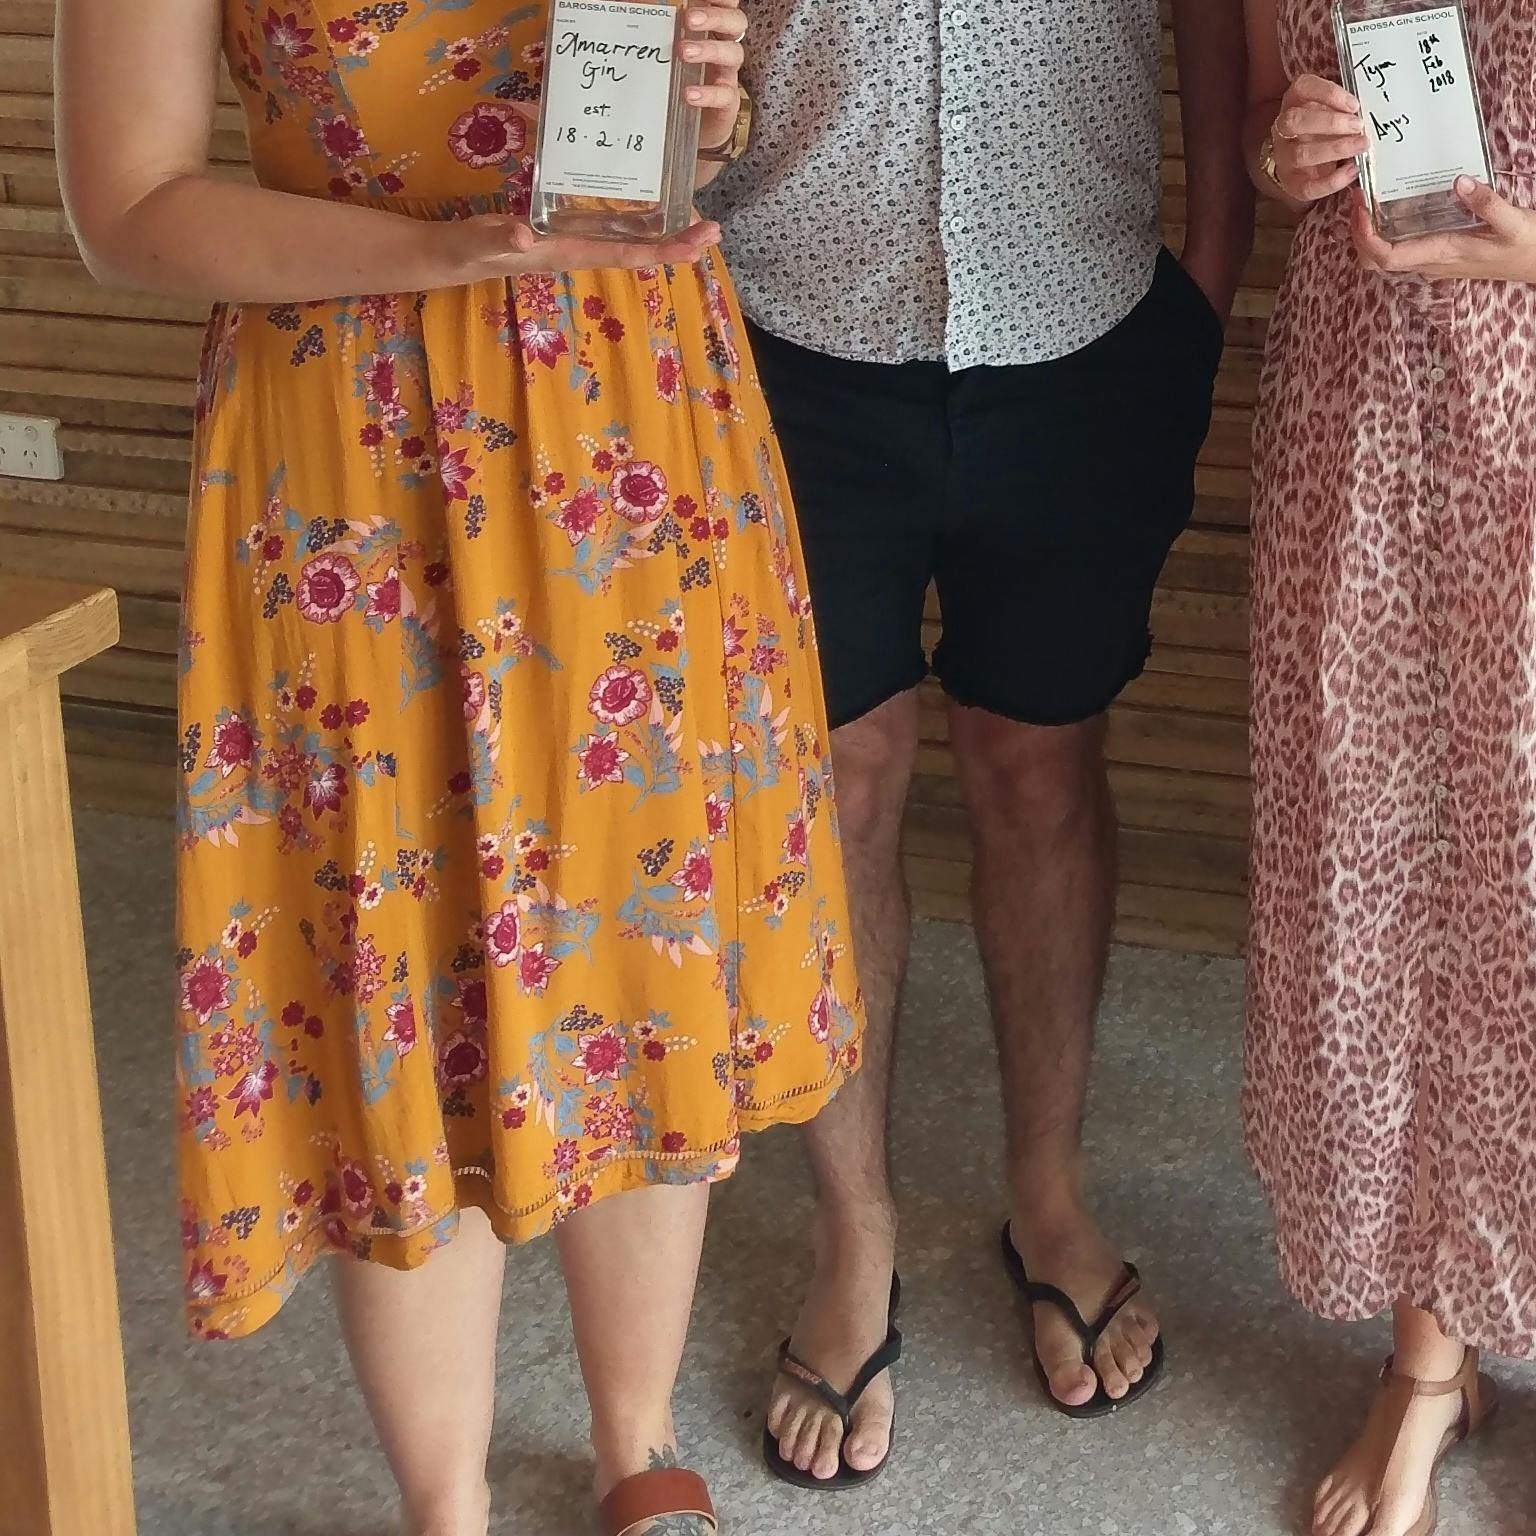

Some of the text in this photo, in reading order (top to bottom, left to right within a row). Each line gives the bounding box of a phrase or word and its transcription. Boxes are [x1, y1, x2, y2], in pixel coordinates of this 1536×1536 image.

[559, 1, 671, 17] BAROSSA GIN SCHOOL
[1350, 11, 1454, 34] BAROSSA GIN SCHOOL
[580, 59, 628, 90] Gin
[1422, 55, 1444, 75] Feb
[1429, 70, 1455, 93] 2018
